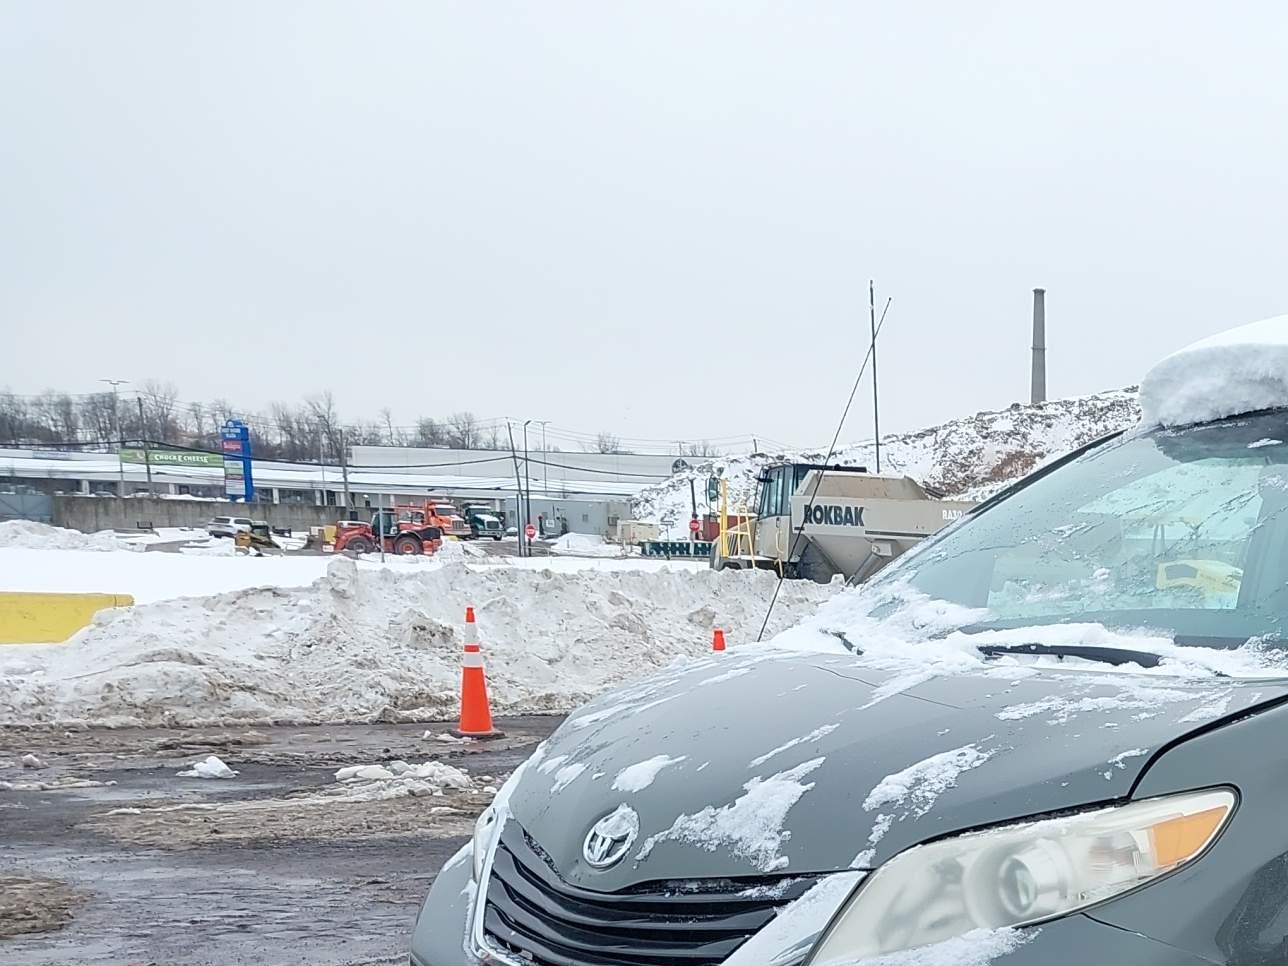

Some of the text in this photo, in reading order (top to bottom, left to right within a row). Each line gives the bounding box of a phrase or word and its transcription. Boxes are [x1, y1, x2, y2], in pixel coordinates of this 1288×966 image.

[154, 453, 209, 463] CHUCK E CHEESE
[804, 504, 864, 526] ROKBAK
